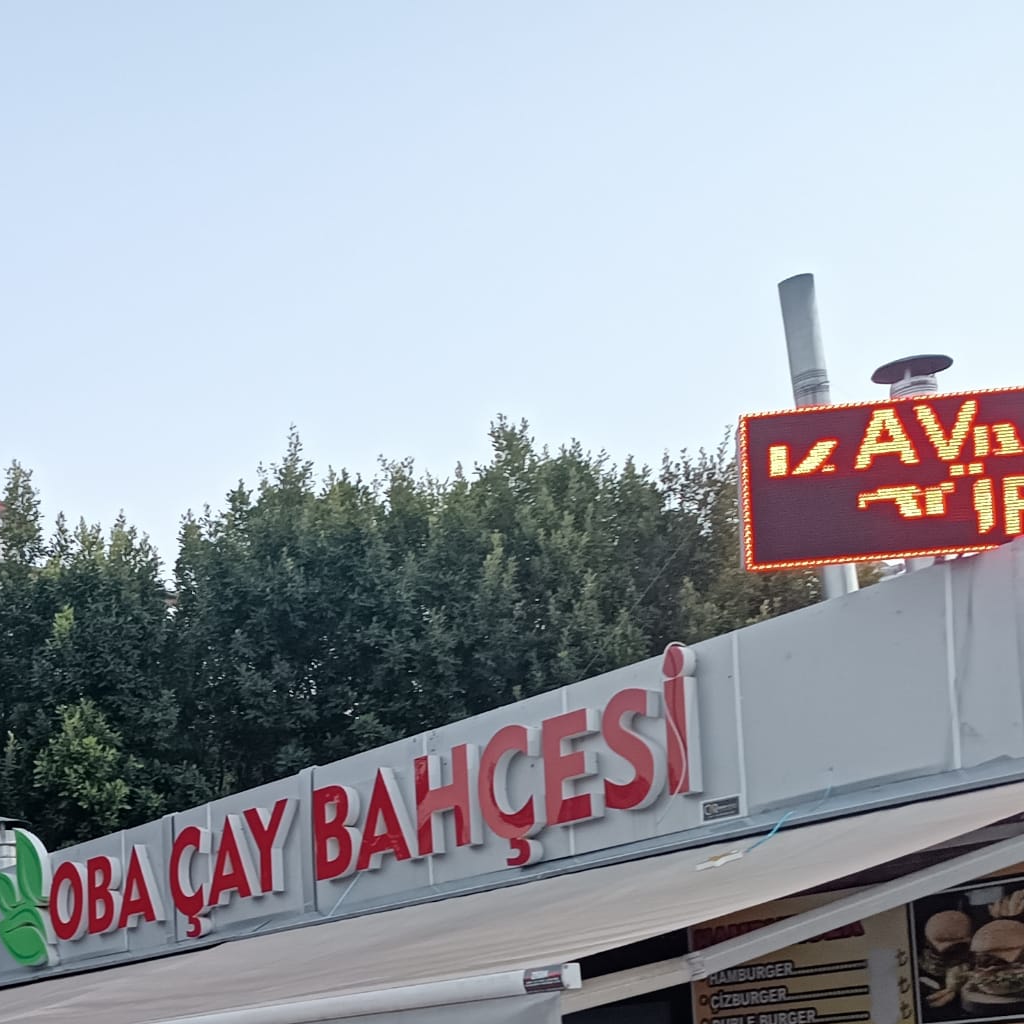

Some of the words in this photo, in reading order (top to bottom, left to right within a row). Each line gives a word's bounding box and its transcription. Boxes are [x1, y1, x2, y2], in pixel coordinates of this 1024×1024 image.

[48, 845, 160, 941] OBA
[169, 799, 291, 938] ÇAY
[312, 644, 695, 881] BAHÇESİ
[708, 961, 793, 986] HAMBURGER
[710, 986, 787, 1012] ÇİZBURGER
